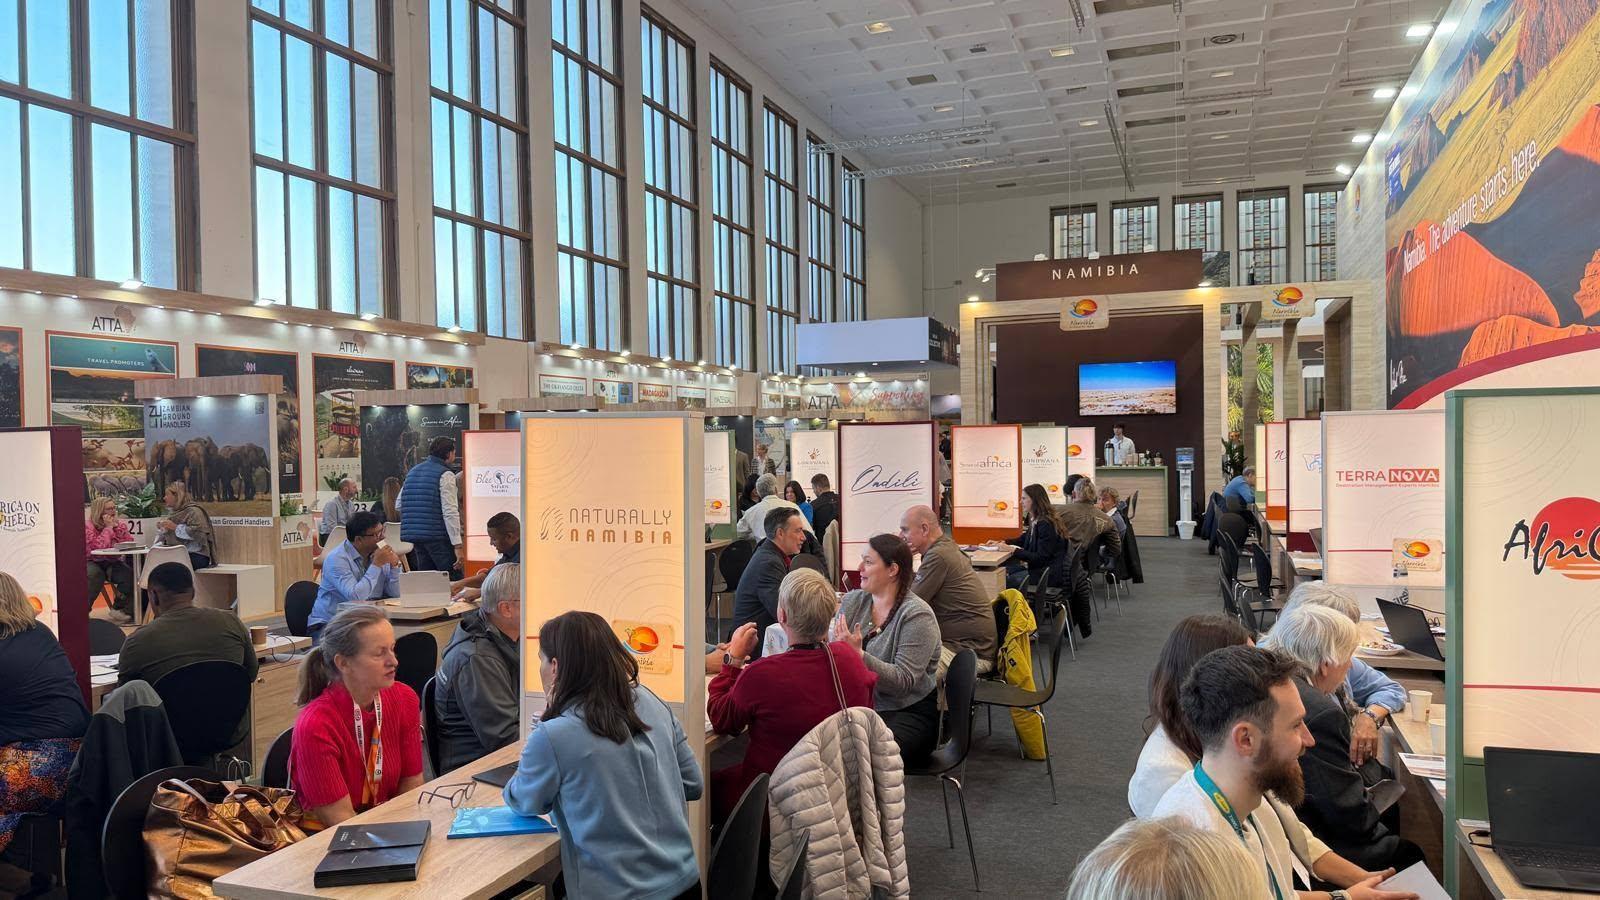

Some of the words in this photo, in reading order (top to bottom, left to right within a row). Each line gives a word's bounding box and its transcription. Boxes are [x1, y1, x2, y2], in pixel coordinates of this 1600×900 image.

[1428, 223, 1440, 256] The
[1441, 193, 1478, 245] adventure
[1480, 163, 1508, 213] starts
[1511, 139, 1540, 188] here.
[1052, 263, 1139, 280] NAMIBIA
[91, 316, 123, 333] ATTA
[339, 341, 359, 353] ATTA
[87, 356, 110, 364] TRAVEL
[110, 359, 145, 367] PROMOTERS
[162, 404, 191, 412] ZAMBIAN
[808, 395, 840, 410] ATTA
[162, 412, 191, 420] GROUND
[162, 420, 191, 428] HANDLERS
[851, 464, 920, 492] Ondili
[1336, 470, 1386, 482] TERRA
[1390, 470, 1438, 482] NOVA
[25, 501, 40, 514] ON
[222, 518, 244, 526] Ground
[569, 508, 672, 526] NATURALLY
[127, 520, 144, 535] 21
[282, 531, 304, 544] ATTA
[569, 528, 672, 545] NAMIBIA
